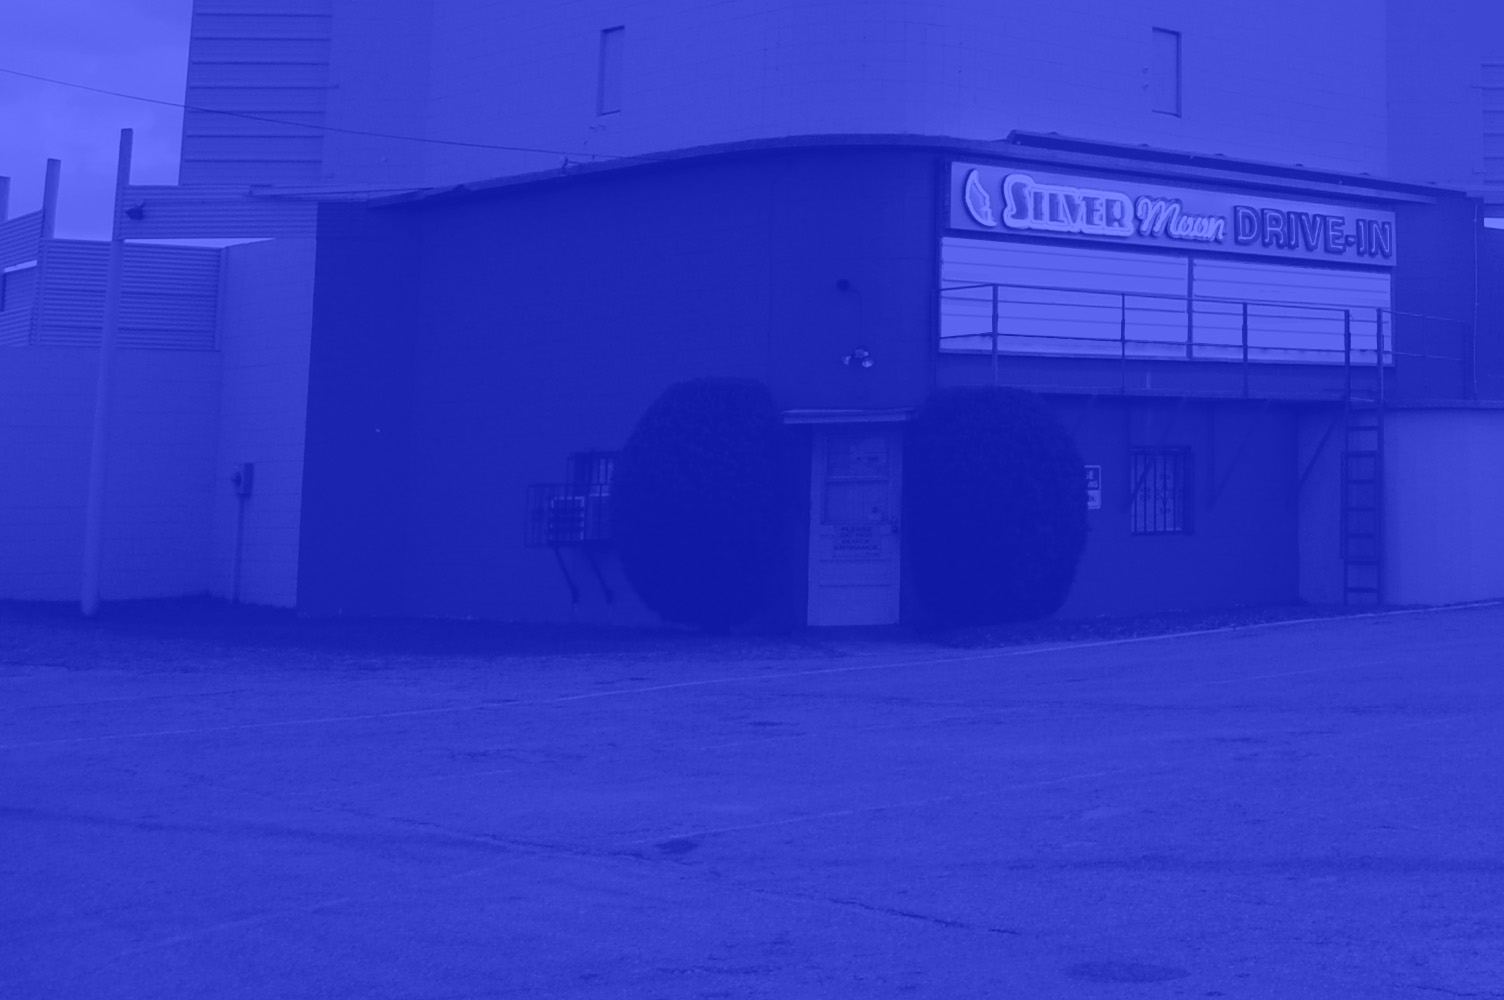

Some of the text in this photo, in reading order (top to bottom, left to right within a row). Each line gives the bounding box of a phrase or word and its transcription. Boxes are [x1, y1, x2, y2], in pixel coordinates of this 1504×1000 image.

[1002, 173, 1394, 258] SILVER Moon DRIVE-IN
